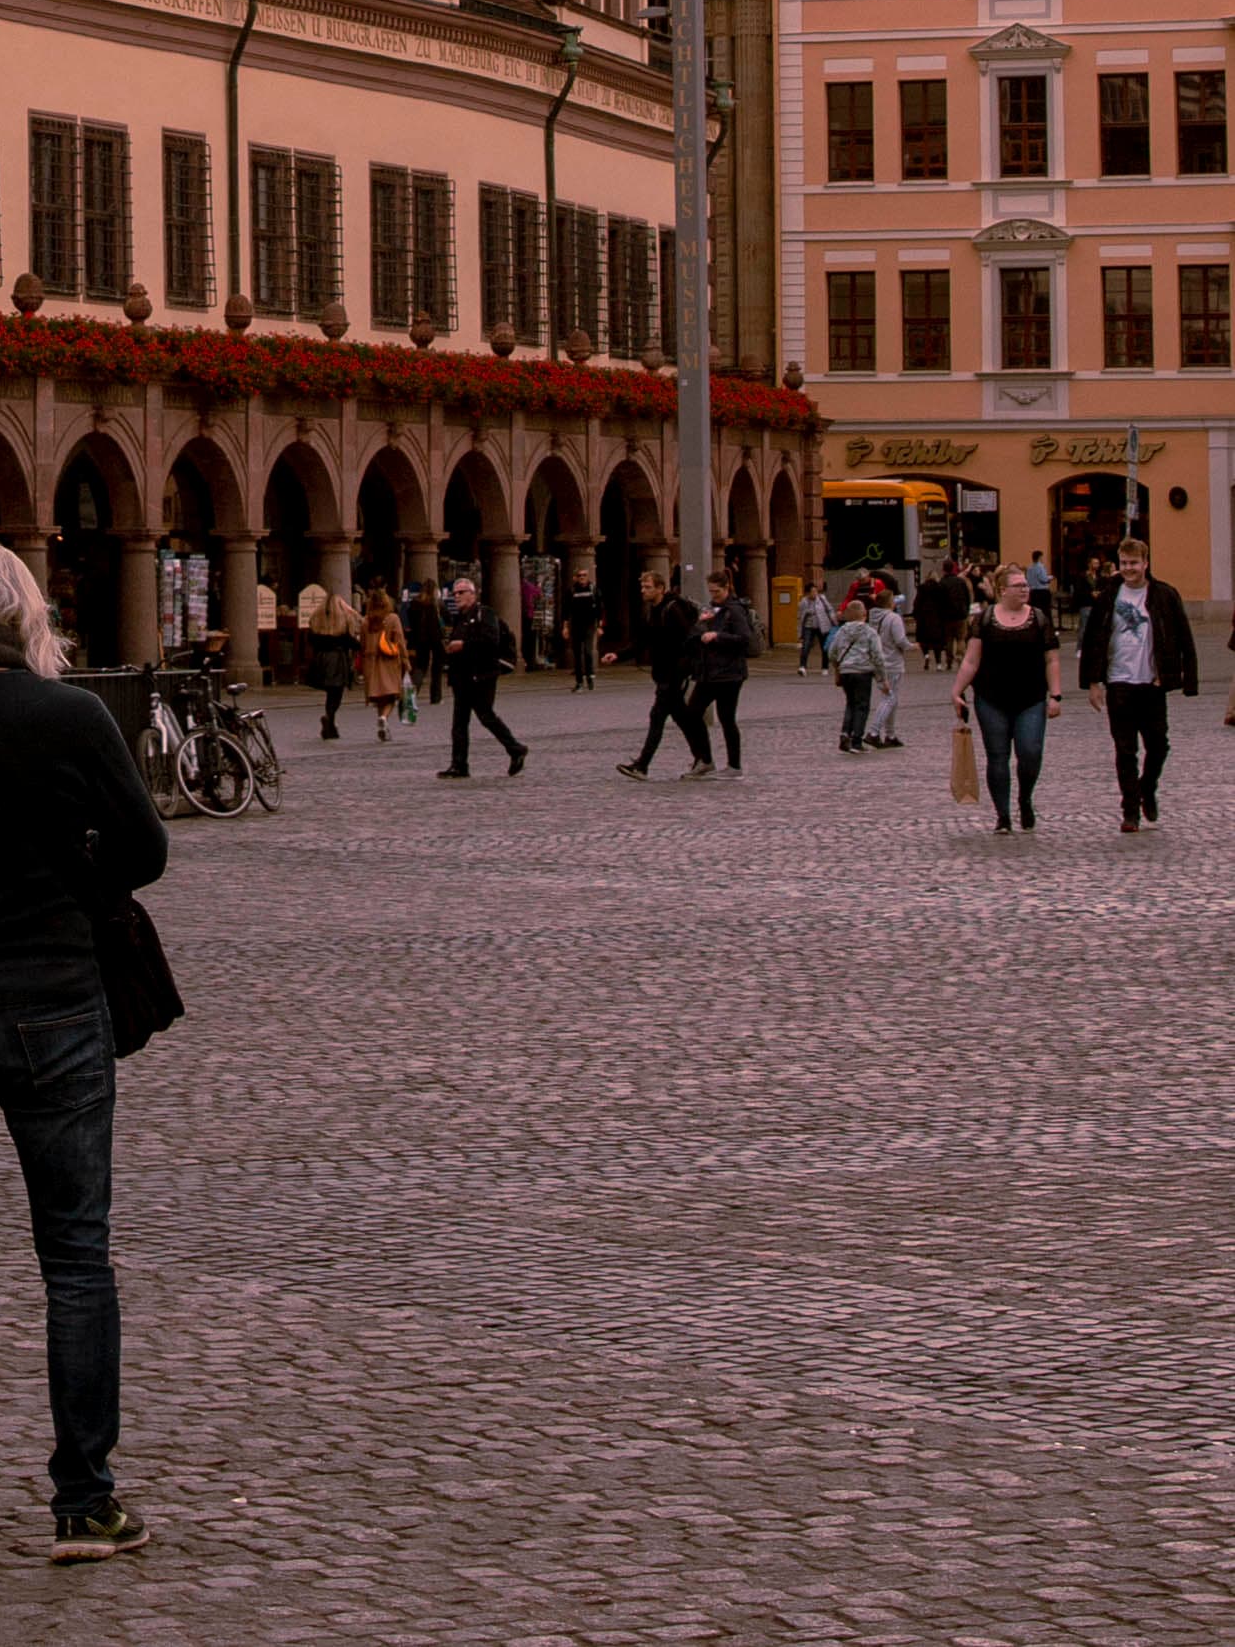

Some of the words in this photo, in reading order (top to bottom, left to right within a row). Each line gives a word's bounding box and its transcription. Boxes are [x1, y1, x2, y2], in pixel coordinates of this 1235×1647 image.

[255, 6, 307, 35] MEISSEN
[326, 19, 408, 55] BURGGRAFFEN
[415, 36, 431, 59] ZU
[438, 41, 500, 74] MAGDEBURG
[679, 241, 699, 371] MUSEUM
[883, 439, 978, 467] Tchibo
[1067, 437, 1166, 467] Tchio
